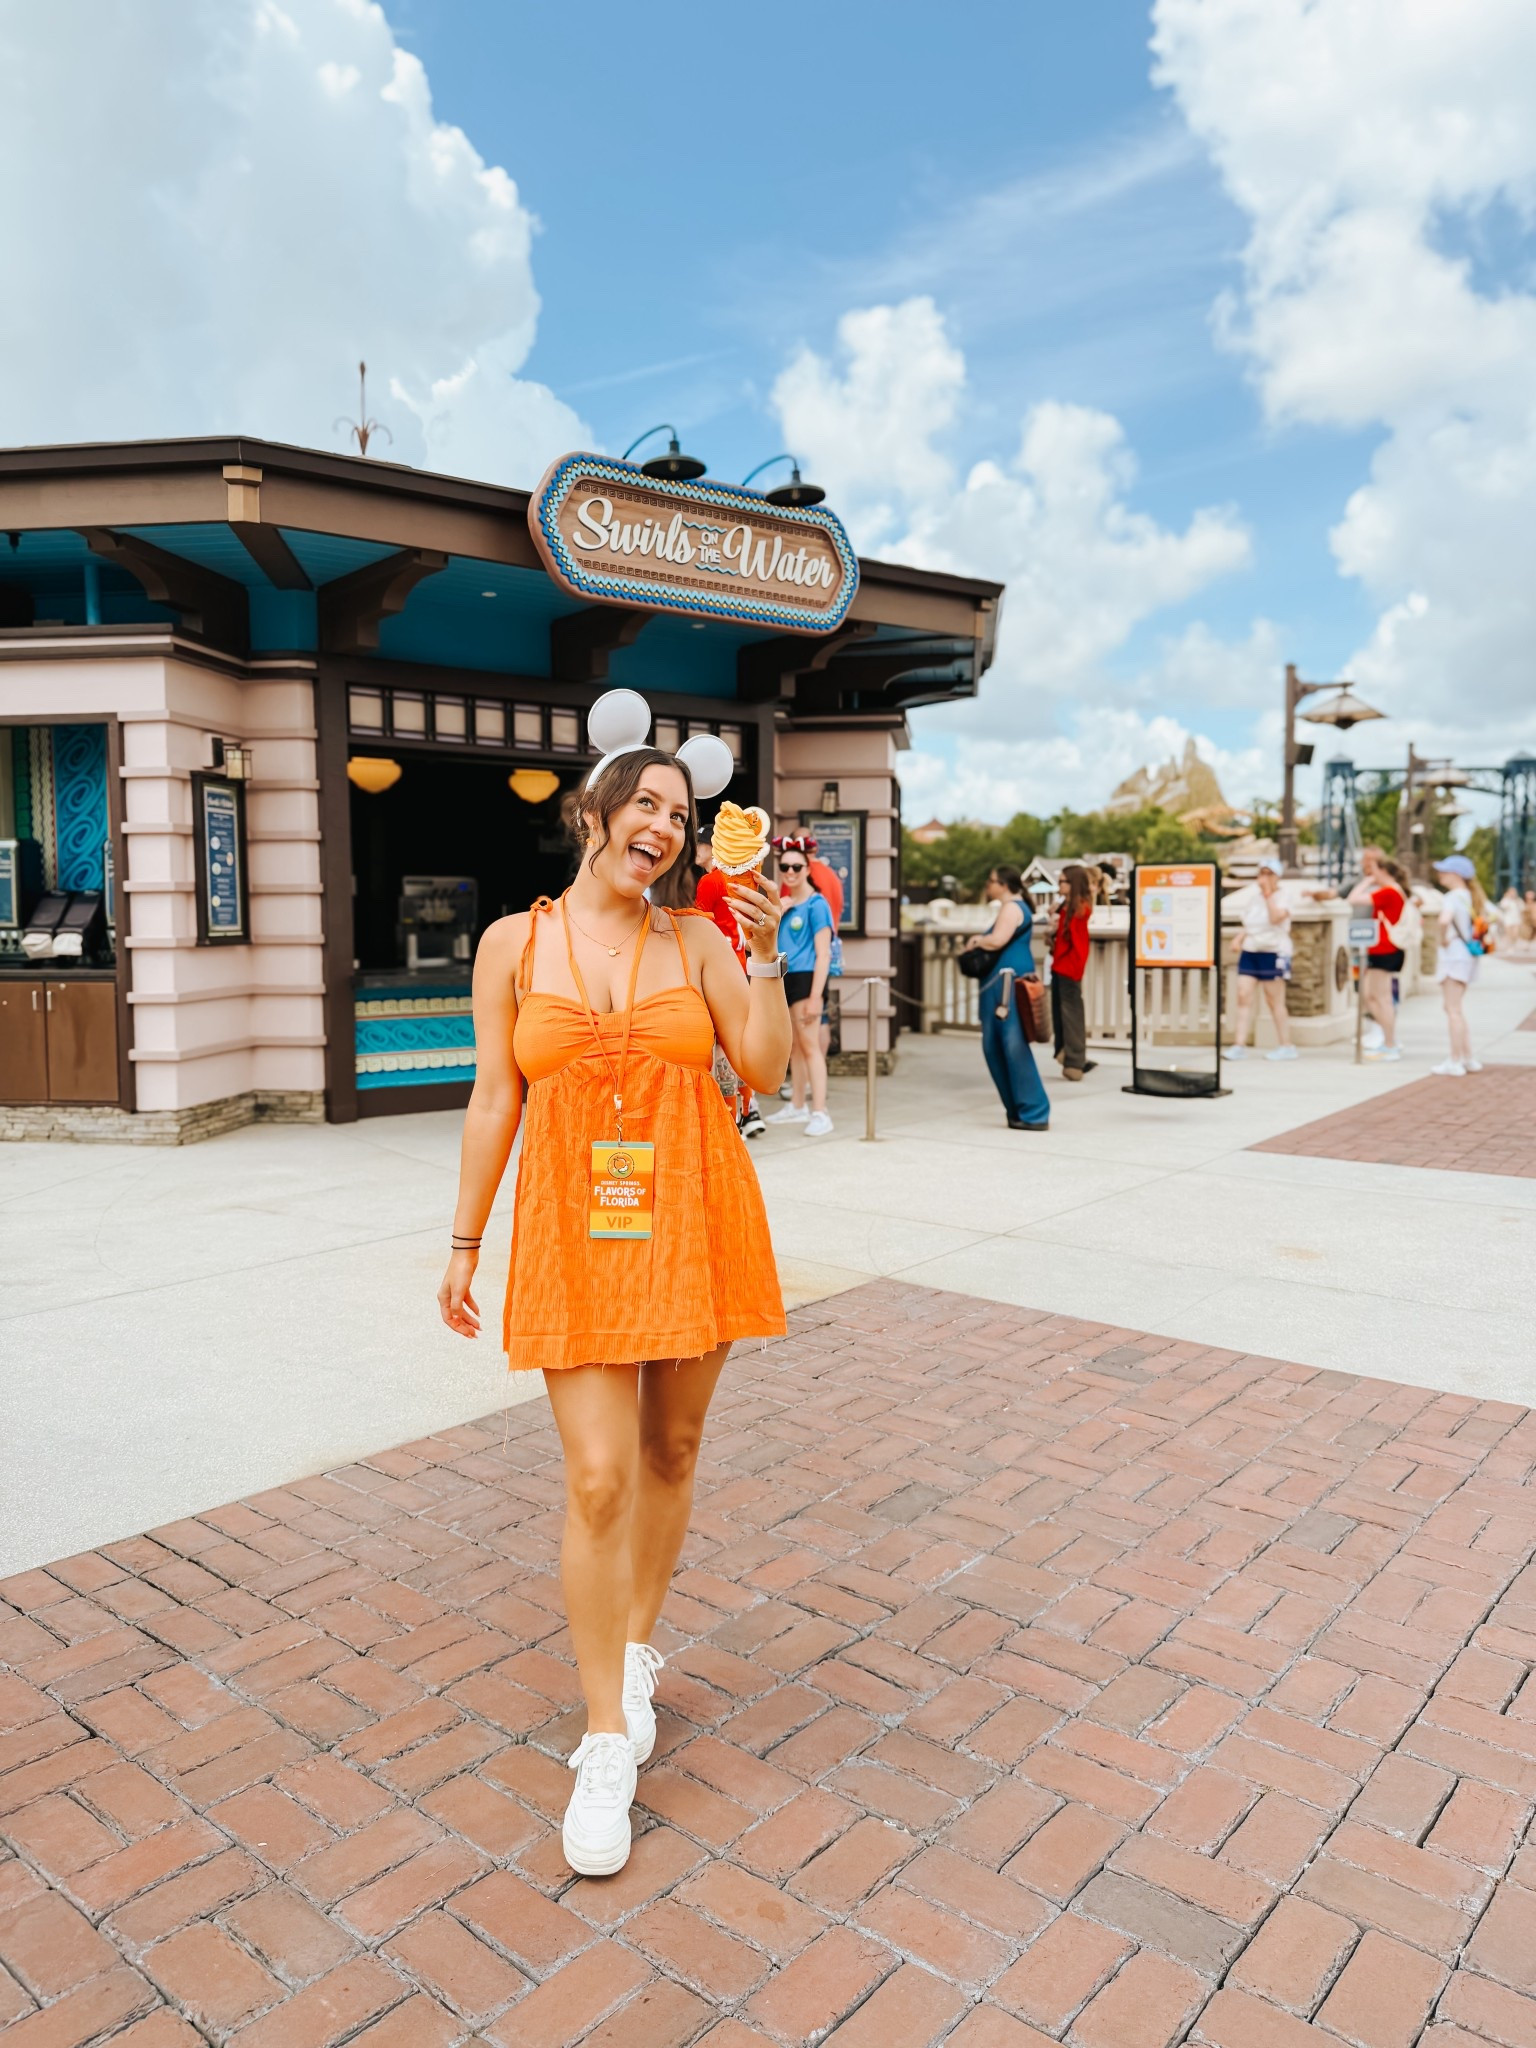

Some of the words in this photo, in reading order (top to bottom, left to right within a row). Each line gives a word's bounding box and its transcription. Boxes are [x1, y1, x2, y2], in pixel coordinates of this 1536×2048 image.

[573, 497, 697, 565] Swirls
[701, 531, 719, 546] ON
[697, 545, 721, 564] THE
[723, 525, 834, 588] Water
[594, 1186, 636, 1197] FLAVORS
[636, 1188, 647, 1196] OF
[600, 1196, 639, 1207] FLORIDA
[606, 1216, 633, 1229] VIP
